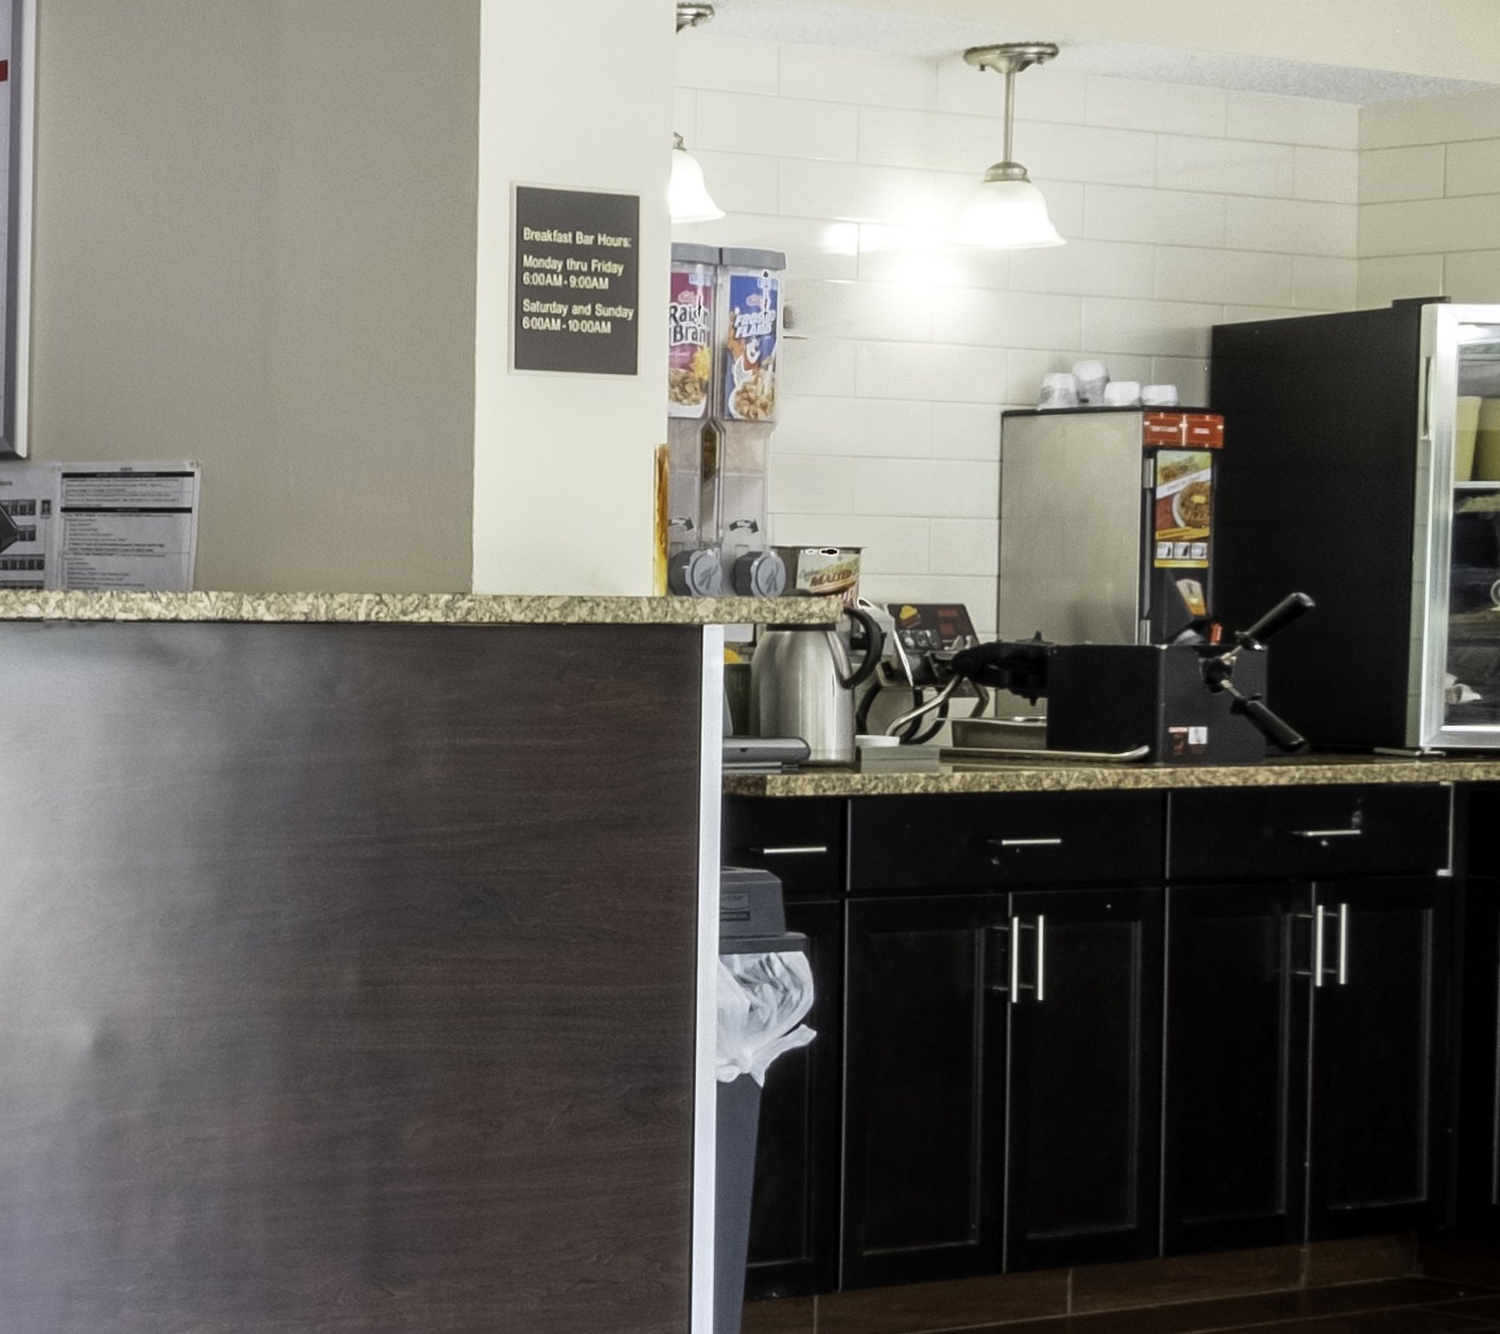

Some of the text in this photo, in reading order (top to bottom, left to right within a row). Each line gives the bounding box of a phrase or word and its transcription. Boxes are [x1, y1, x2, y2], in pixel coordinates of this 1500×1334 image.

[523, 227, 632, 248] Breakfast Bar Hours:
[523, 254, 624, 277] Monday thru Friday
[522, 272, 563, 287] 6:00AM
[569, 275, 609, 289] 9:00AM
[522, 298, 635, 321] Saturday and Sunday
[522, 317, 561, 331] 6:00AM
[567, 319, 612, 334] 10:00AM
[673, 325, 706, 343] Bran
